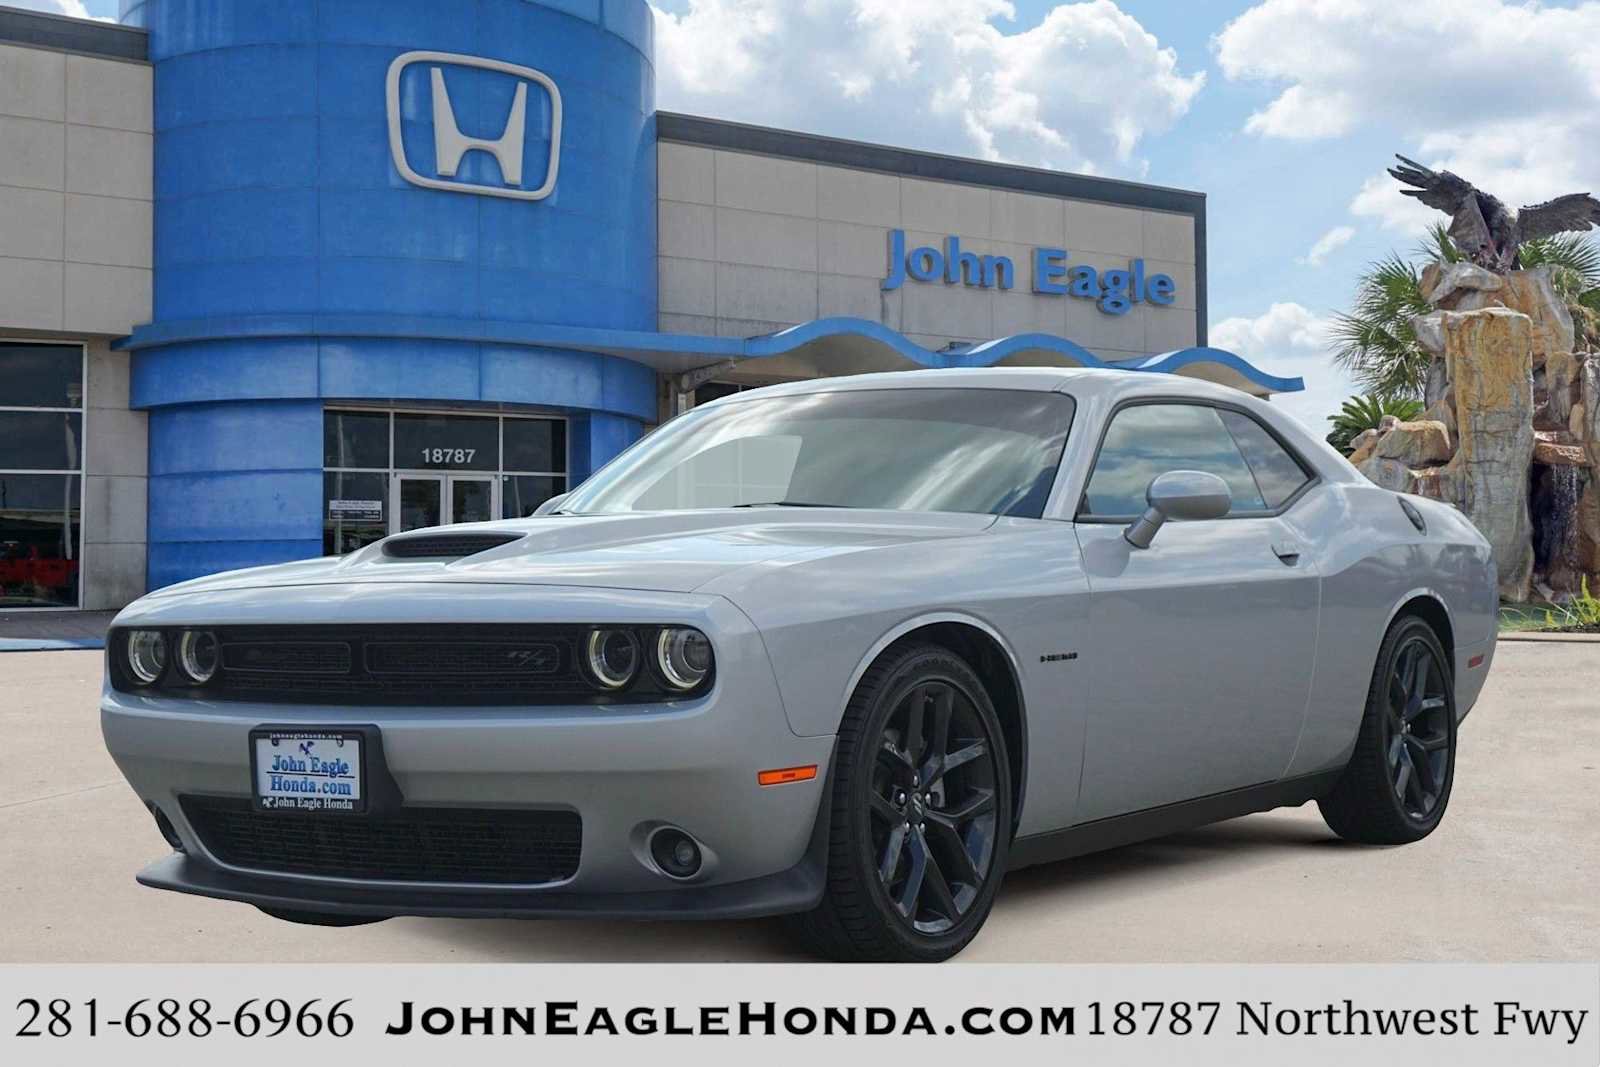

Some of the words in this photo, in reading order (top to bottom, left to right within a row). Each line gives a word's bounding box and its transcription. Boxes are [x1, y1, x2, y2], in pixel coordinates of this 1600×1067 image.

[880, 229, 1014, 291] John
[1031, 247, 1176, 316] Eagle
[421, 448, 476, 464] 18787
[272, 755, 306, 772] John
[310, 757, 349, 778] Eagle
[270, 776, 352, 795] Honda.com
[273, 797, 296, 809] John
[297, 798, 322, 810] Eagle
[324, 799, 353, 810] Honda
